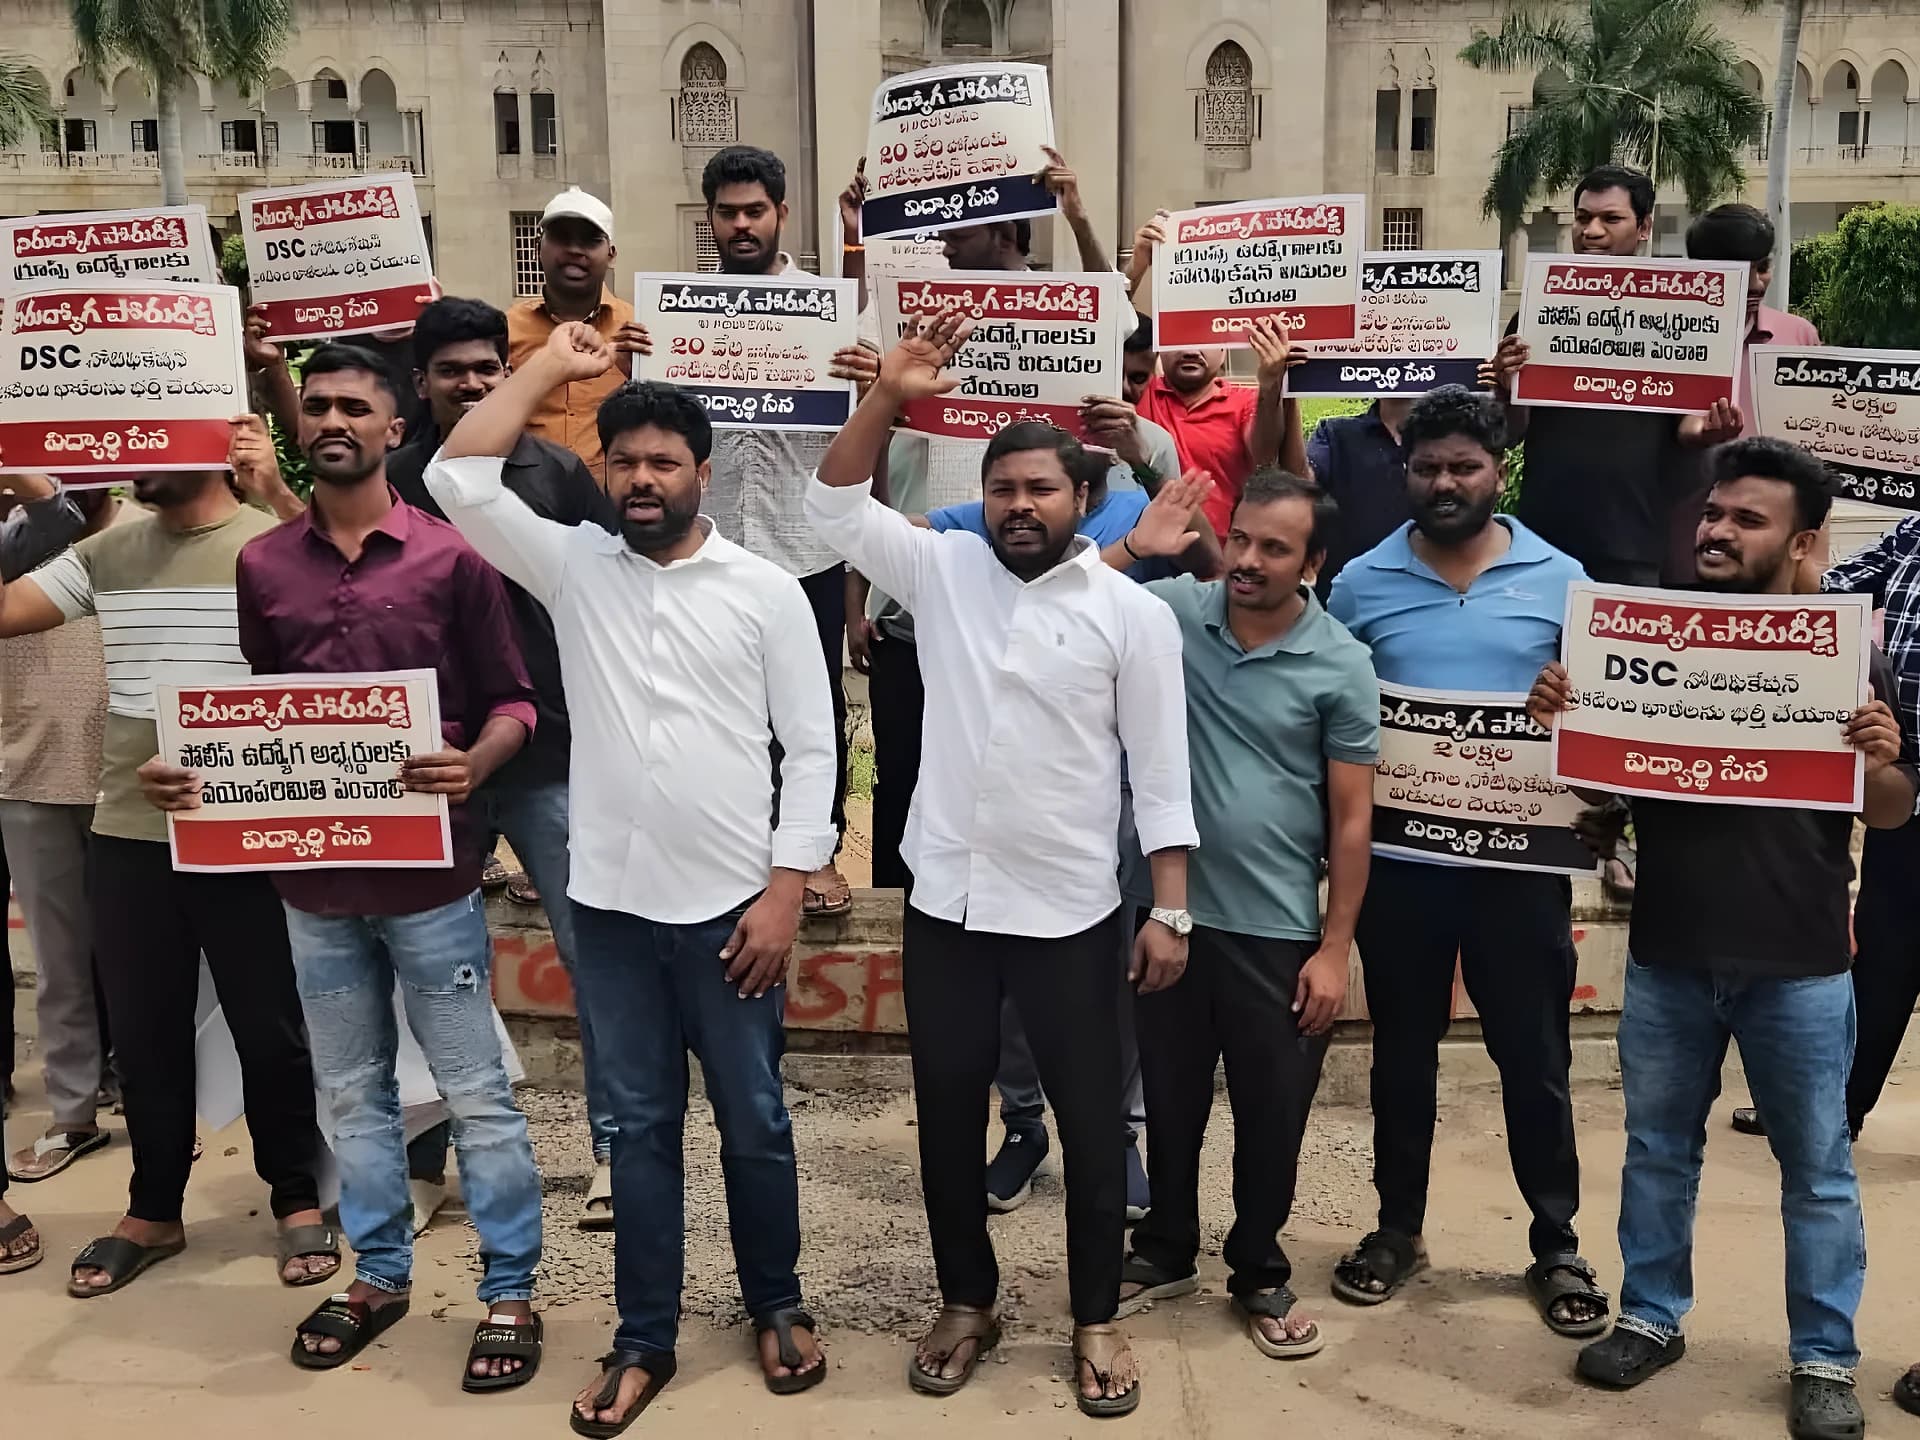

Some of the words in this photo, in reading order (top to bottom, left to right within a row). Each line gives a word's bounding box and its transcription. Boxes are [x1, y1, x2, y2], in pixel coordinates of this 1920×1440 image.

[877, 83, 945, 115] రుద్యోగ
[880, 143, 908, 165] 20
[16, 226, 100, 253] నిరుద్యోగ
[101, 218, 185, 247] పోరుదీక్ష
[266, 238, 305, 260] DSC
[661, 285, 751, 317] నిరుద్యోగ
[755, 289, 836, 321] పోరుదీక్ష
[901, 284, 1000, 318] నిరుద్యోగ
[1003, 284, 1096, 321] పోరుదీక్ష
[1547, 267, 1637, 299] నిరుద్యోగ
[1639, 271, 1724, 305] పోరుదీక్ష
[105, 296, 215, 335] పోరుదీక్ష
[21, 345, 81, 370] DSC
[670, 337, 705, 355] 20
[1776, 360, 1872, 394] నిరుద్యోగ
[44, 431, 122, 461] విద్యార్థి
[125, 425, 169, 450] సేన
[1881, 476, 1915, 498] సేన
[1590, 604, 1706, 649] నిరుద్యోగ
[1711, 610, 1837, 654] పోరుదీక్ష
[1604, 654, 1678, 686] DSC
[1683, 670, 1799, 696] నోటిఫికేషన్
[181, 694, 299, 729] నిరుద్యోగ
[302, 687, 410, 728] పోరుదీక్ష
[179, 742, 234, 768] పోలీస్
[242, 738, 304, 775] ఉద్యోగ
[1433, 742, 1453, 756] 2
[1460, 743, 1512, 771] లక్షల
[1624, 752, 1713, 790] విద్యార్థి
[1720, 754, 1768, 782] సేన
[201, 778, 326, 804] వయోపరిమితి
[241, 827, 325, 858] విద్యార్థి
[328, 821, 372, 847] సేన
[1404, 819, 1483, 855] విద్యార్థి
[1488, 827, 1529, 851] సేన
